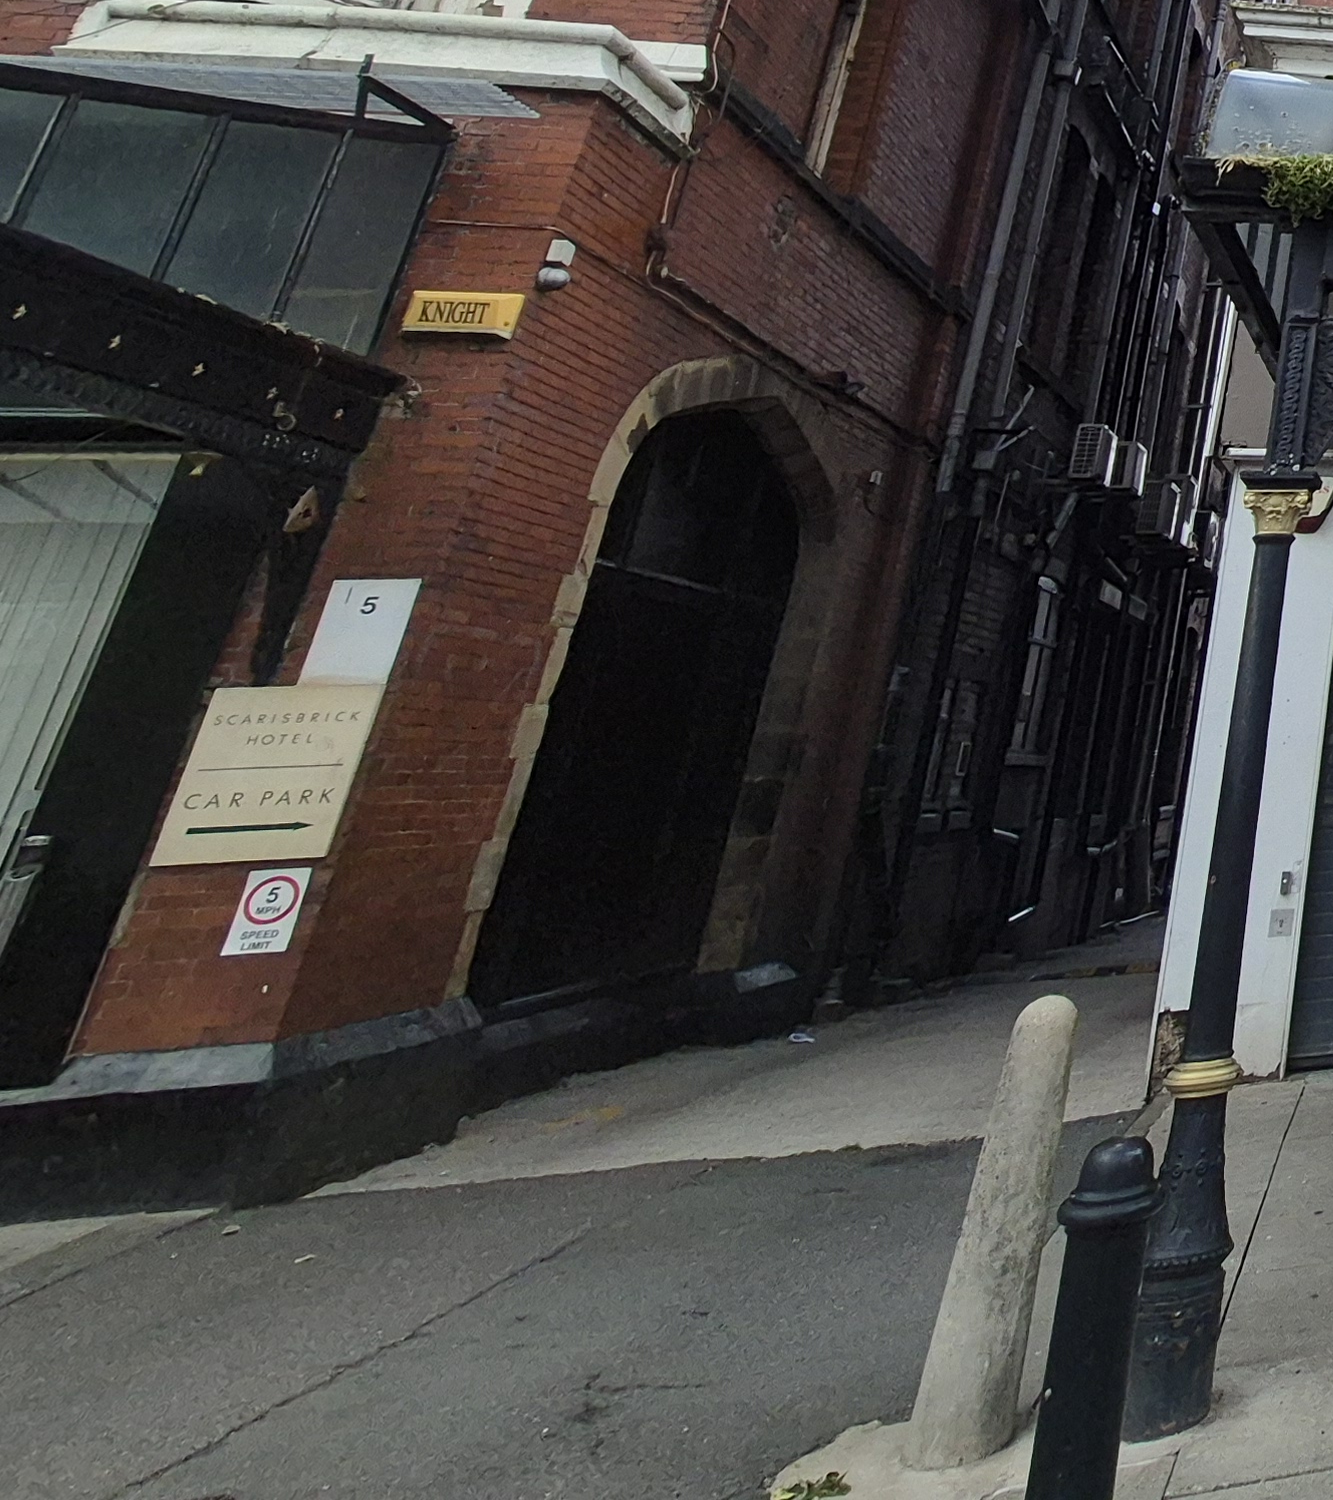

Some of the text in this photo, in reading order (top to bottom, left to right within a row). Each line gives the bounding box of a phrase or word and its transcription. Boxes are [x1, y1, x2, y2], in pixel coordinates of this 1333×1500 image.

[418, 300, 491, 325] KNIGHT
[359, 595, 380, 615] 5
[213, 710, 362, 726] SCARISBRICK
[244, 733, 314, 747] HOTEL
[183, 787, 336, 810] CAR PARK
[265, 886, 282, 904] 5
[255, 905, 282, 915] MPH
[240, 928, 280, 941] SPEED
[240, 940, 272, 952] LIMIT
